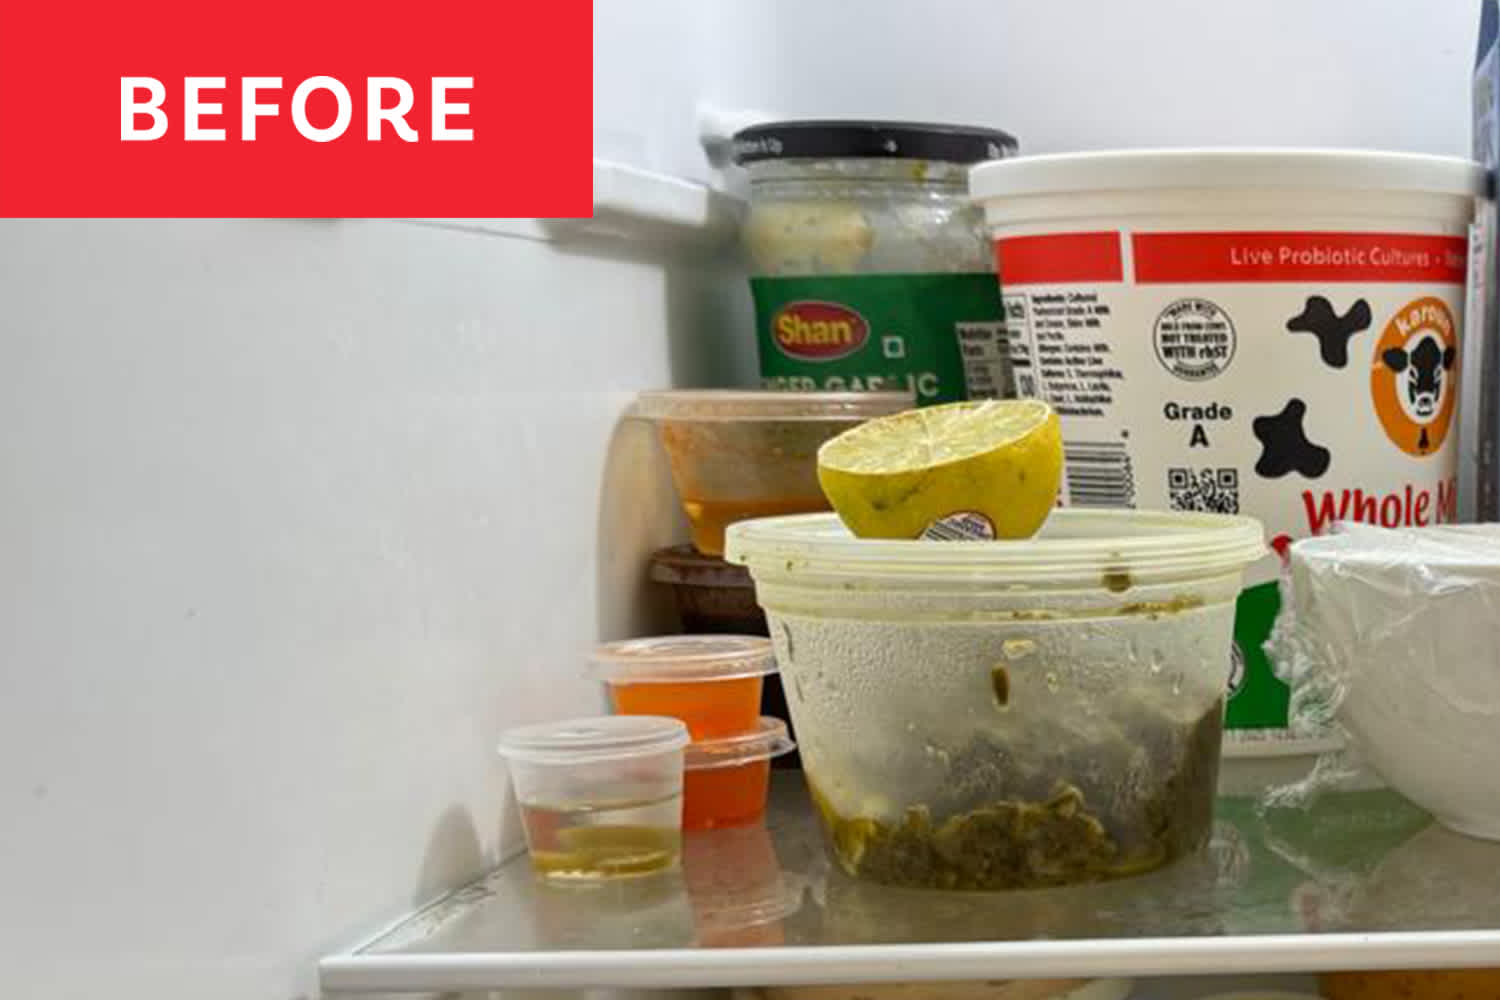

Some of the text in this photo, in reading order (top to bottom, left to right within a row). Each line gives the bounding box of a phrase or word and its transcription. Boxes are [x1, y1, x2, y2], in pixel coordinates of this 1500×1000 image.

[1230, 247, 1273, 266] Live
[1278, 245, 1366, 266] Probiotic
[777, 314, 851, 345] Shan
[1161, 346, 1197, 359] WITH
[825, 372, 940, 397] GARIC
[1163, 401, 1233, 421] Grade
[1189, 423, 1210, 448] A
[1302, 484, 1431, 537] Whole
